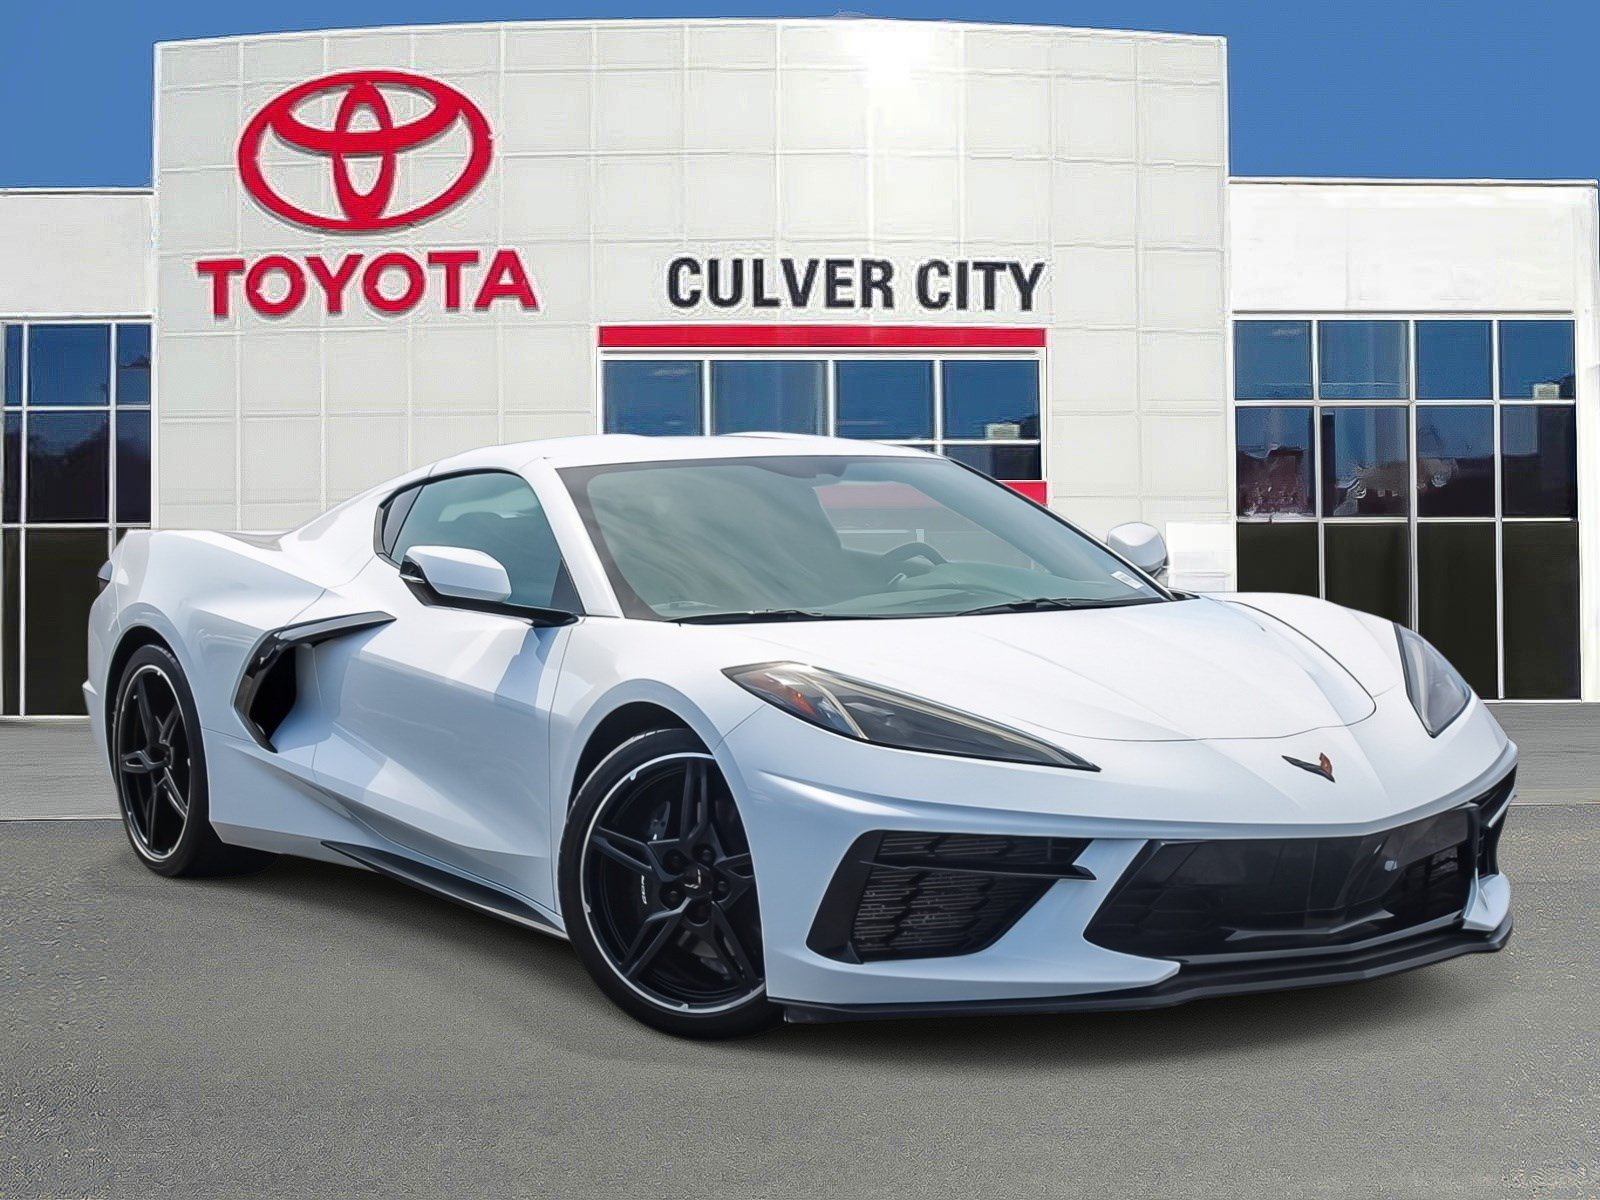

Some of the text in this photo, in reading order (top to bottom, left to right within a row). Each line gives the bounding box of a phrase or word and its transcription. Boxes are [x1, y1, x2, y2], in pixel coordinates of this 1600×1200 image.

[195, 249, 539, 317] TOYOTA
[668, 257, 1046, 312] CULVER CITY
